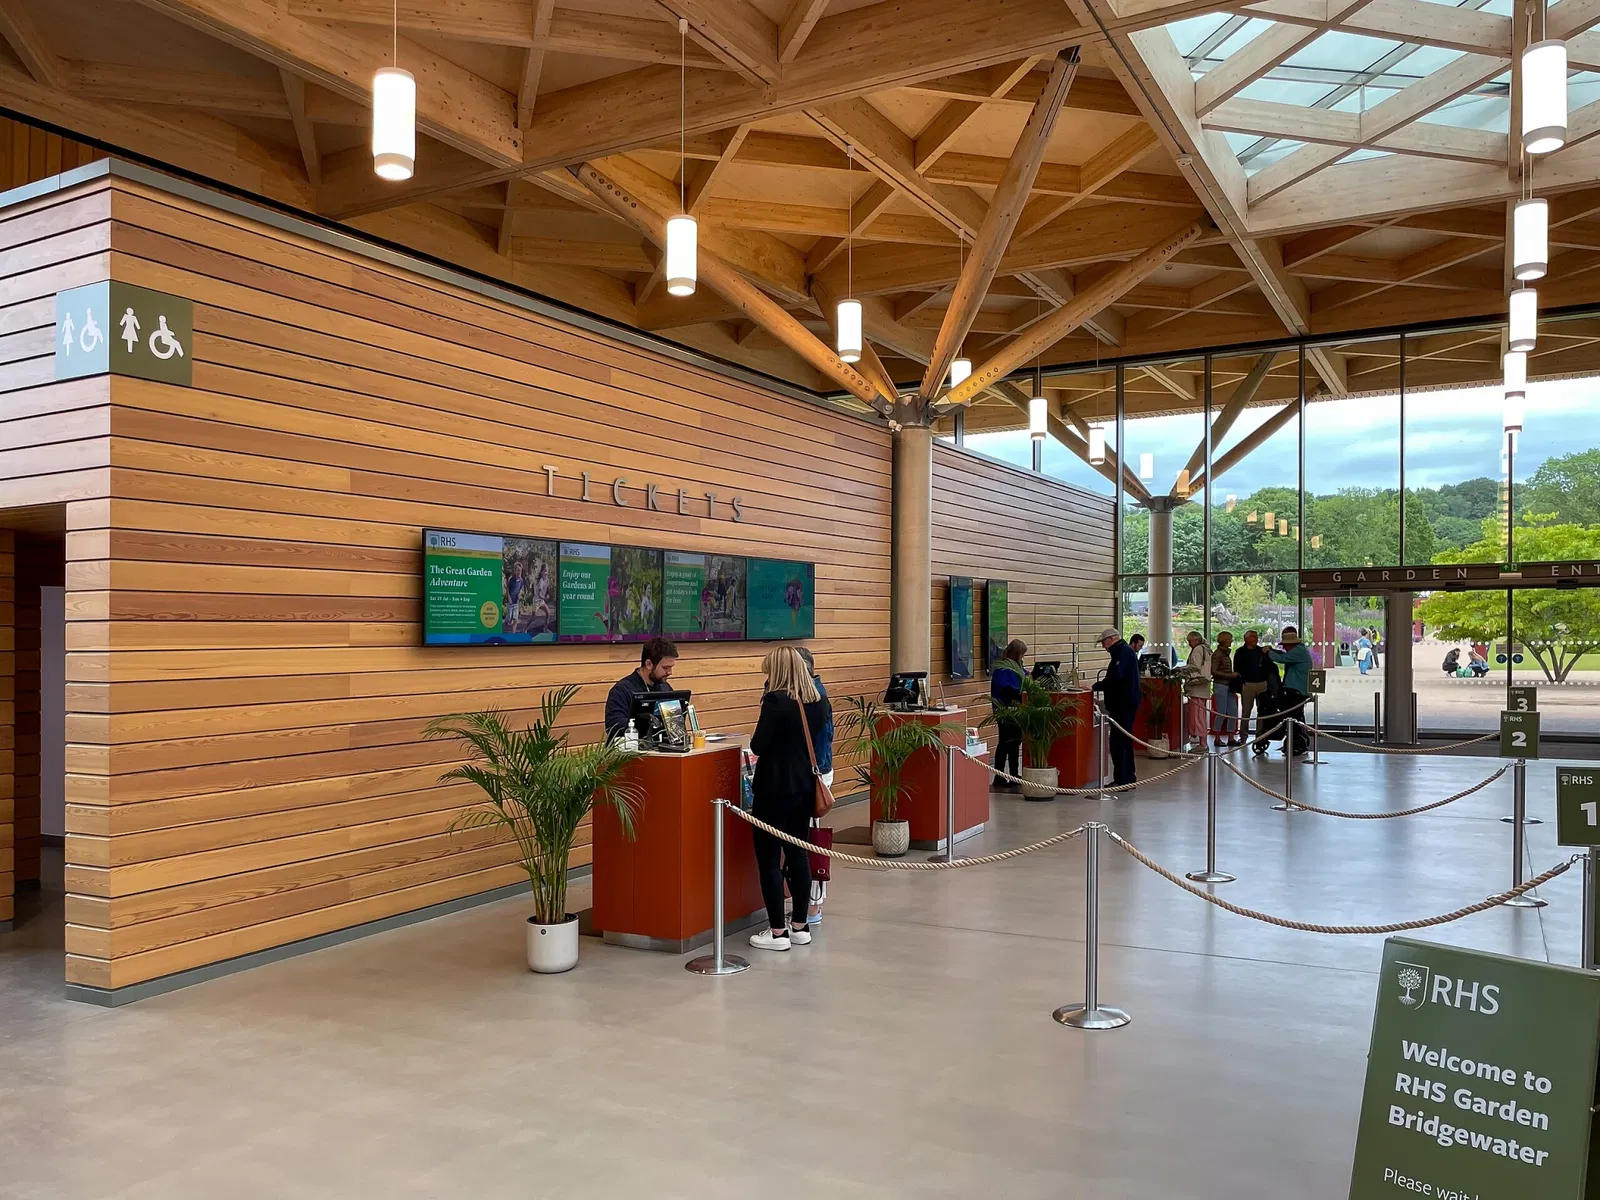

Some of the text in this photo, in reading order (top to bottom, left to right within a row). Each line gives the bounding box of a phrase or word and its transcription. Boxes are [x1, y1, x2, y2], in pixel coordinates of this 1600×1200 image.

[542, 464, 744, 522] TICKETS
[440, 536, 456, 547] RHS
[430, 565, 493, 578] The Great Garden
[562, 570, 580, 580] Enjoy
[1332, 567, 1468, 583] GARDEN
[429, 578, 469, 588] Adventure
[562, 580, 587, 589] Gardens
[562, 592, 595, 601] year round
[1312, 678, 1320, 688] 4
[1517, 698, 1528, 712] 3
[1511, 731, 1527, 747] 2
[1572, 776, 1593, 785] RHS
[1580, 801, 1598, 826] 1
[1431, 974, 1500, 1015] RHS
[1402, 1039, 1552, 1094] Welcome to
[1395, 1072, 1549, 1131] RHS Garden
[1388, 1104, 1549, 1167] Bridgewater
[1384, 1167, 1432, 1195] Please
